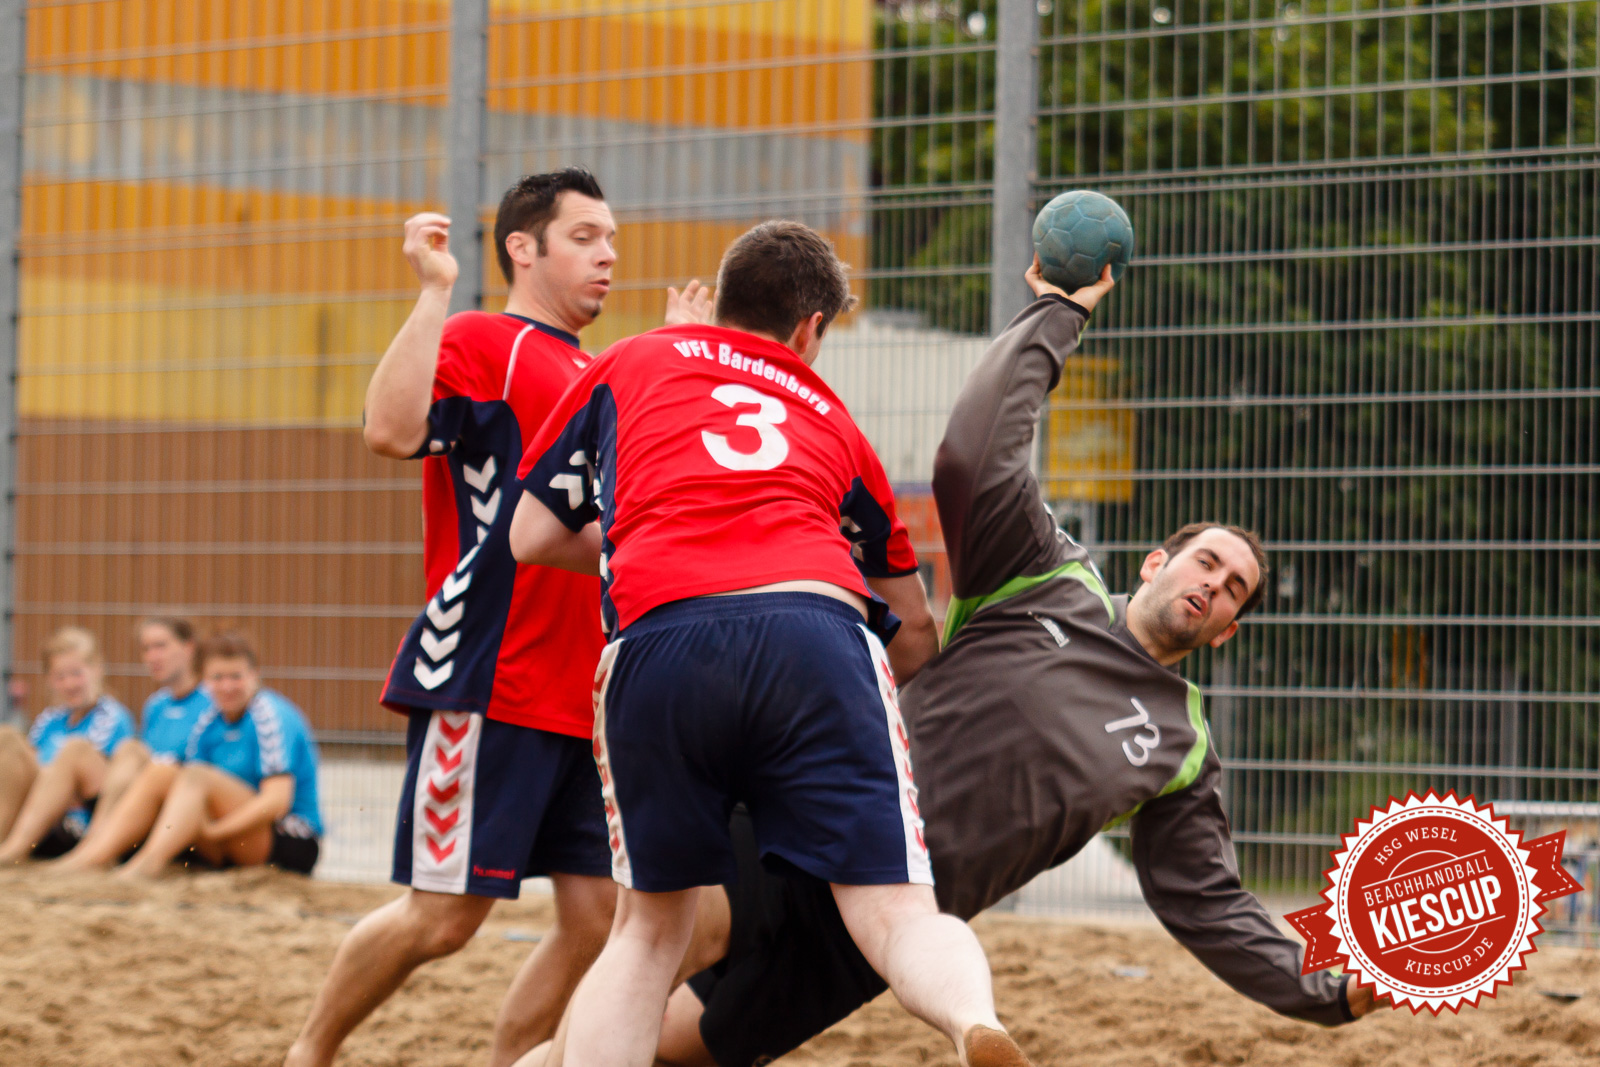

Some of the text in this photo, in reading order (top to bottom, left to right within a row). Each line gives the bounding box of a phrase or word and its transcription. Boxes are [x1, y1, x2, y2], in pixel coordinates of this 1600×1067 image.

[673, 340, 714, 360] VFL
[701, 383, 789, 471] 3
[1104, 697, 1162, 767] 73
